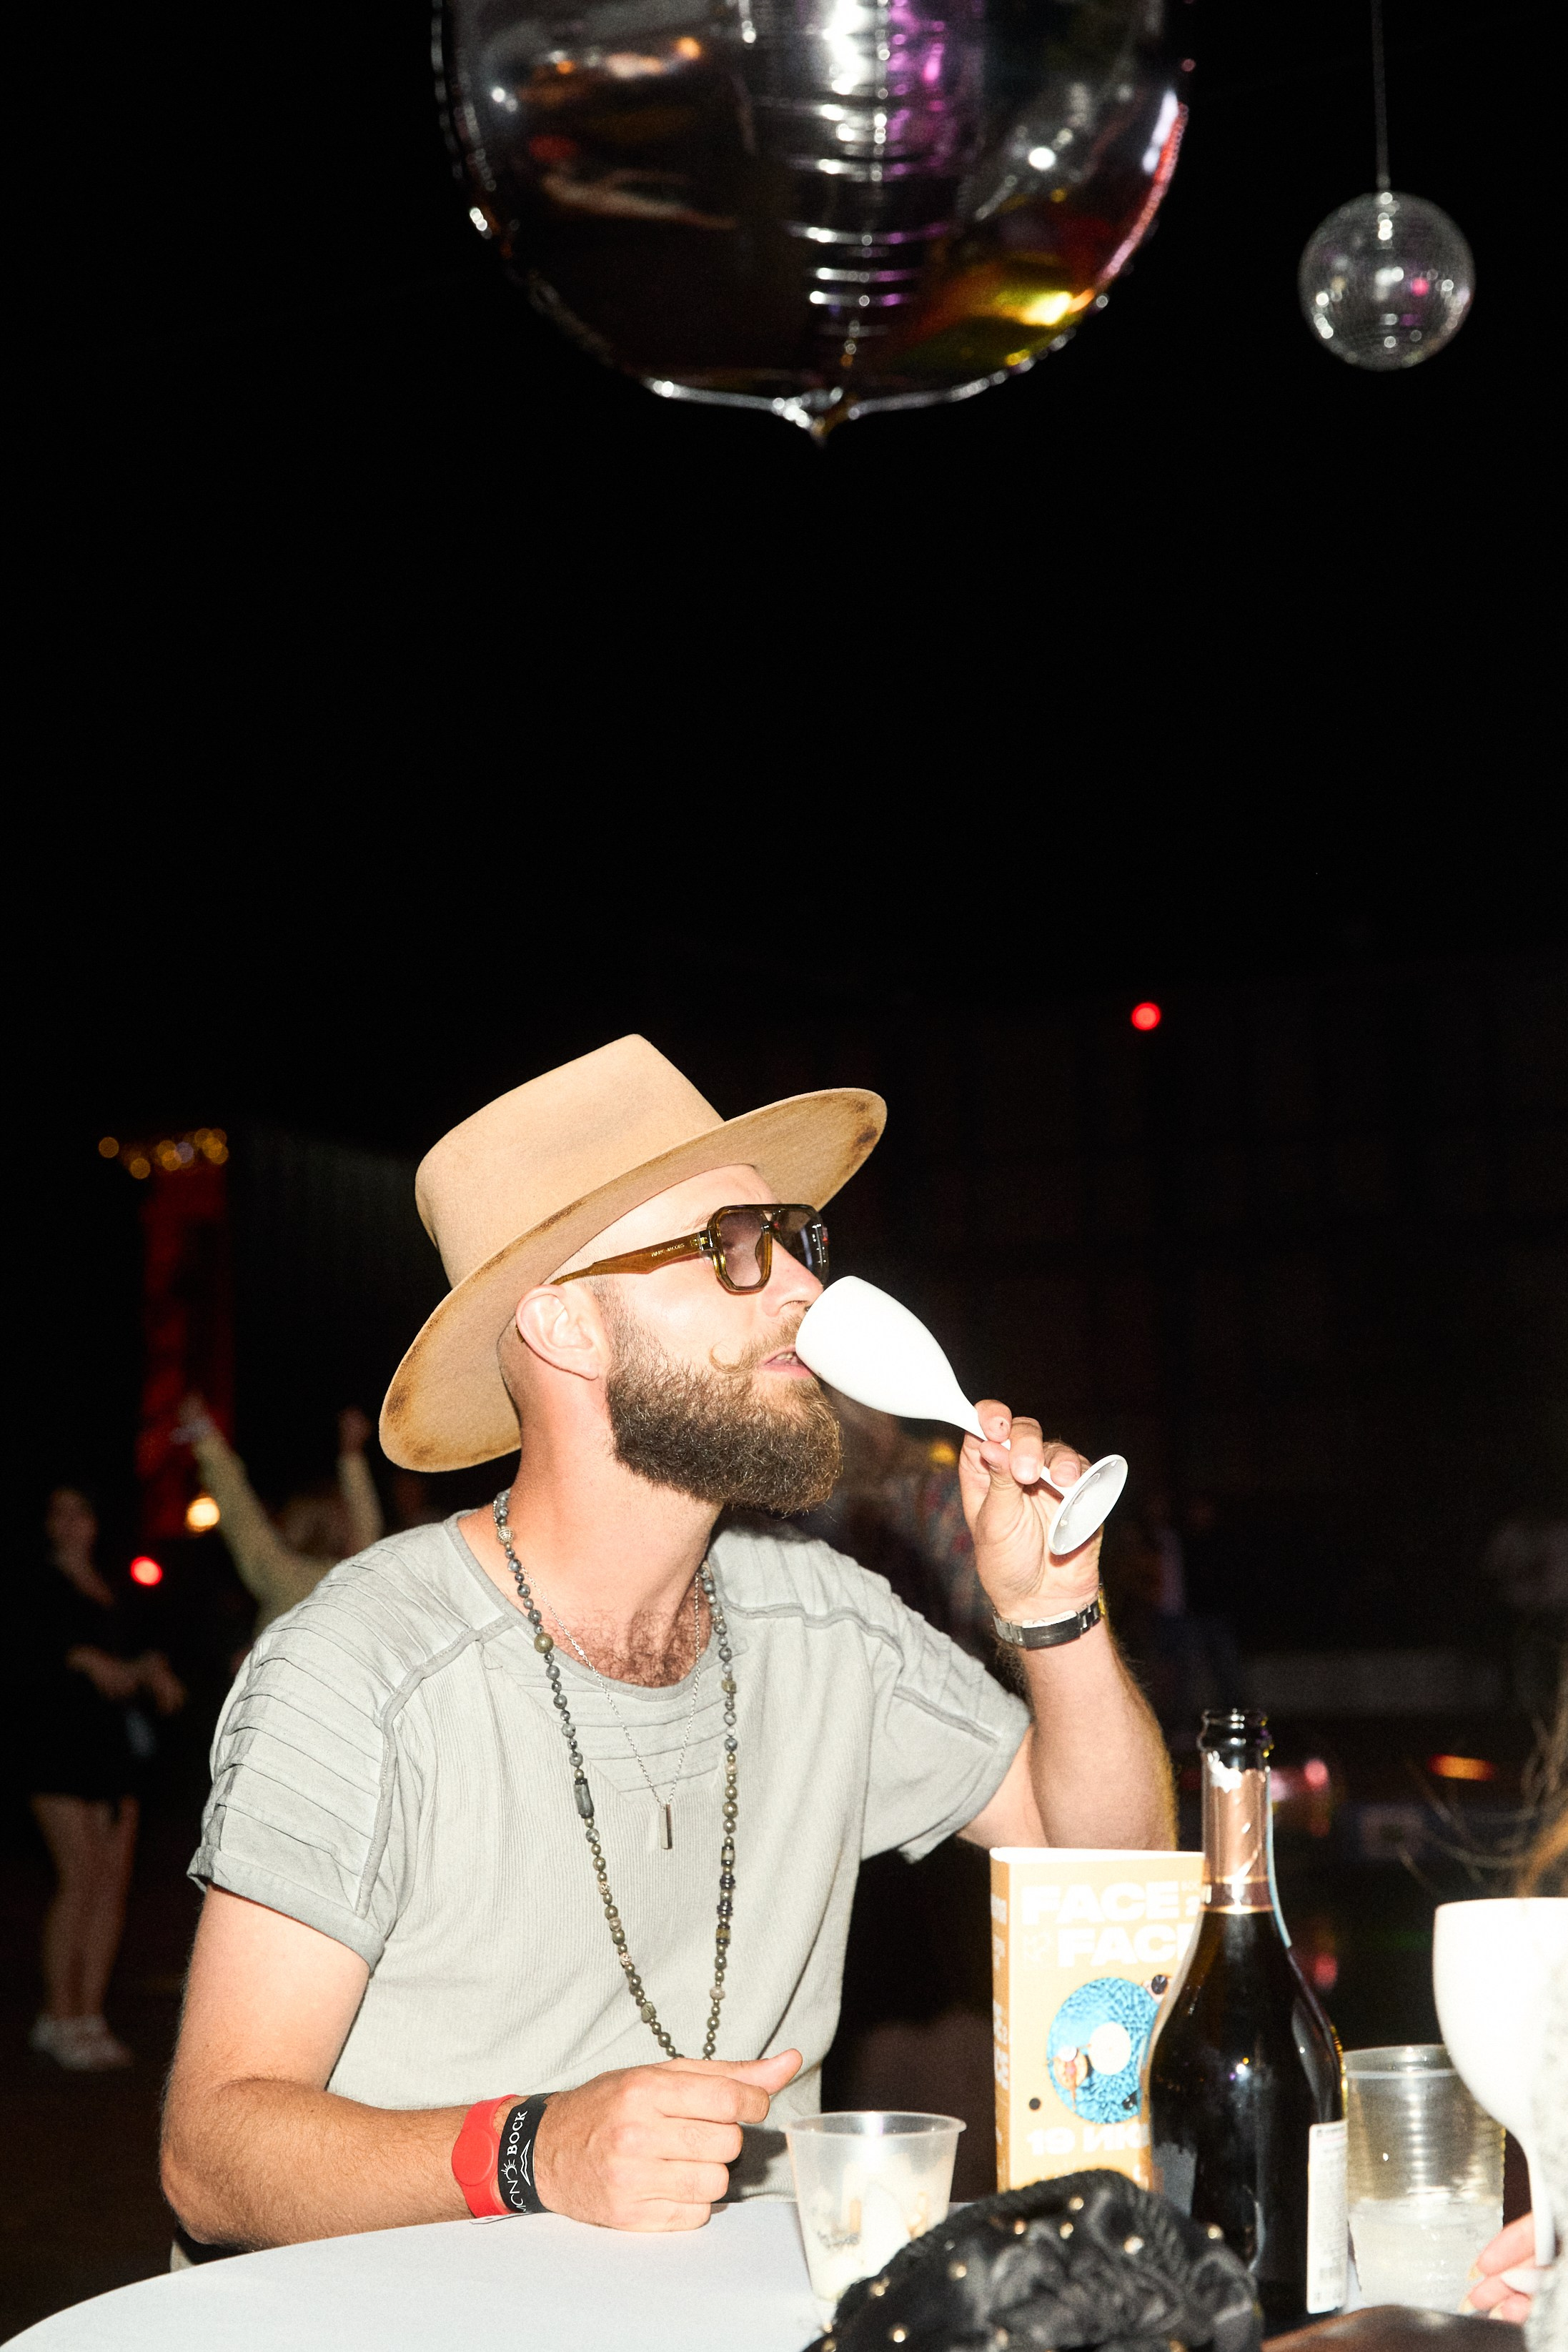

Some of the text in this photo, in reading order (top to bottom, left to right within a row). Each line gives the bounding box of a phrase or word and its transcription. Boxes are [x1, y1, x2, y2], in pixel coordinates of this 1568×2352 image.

[1021, 1881, 1180, 1925] FACE
[507, 2110, 528, 2156] BOCK
[1026, 2126, 1076, 2156] 19
